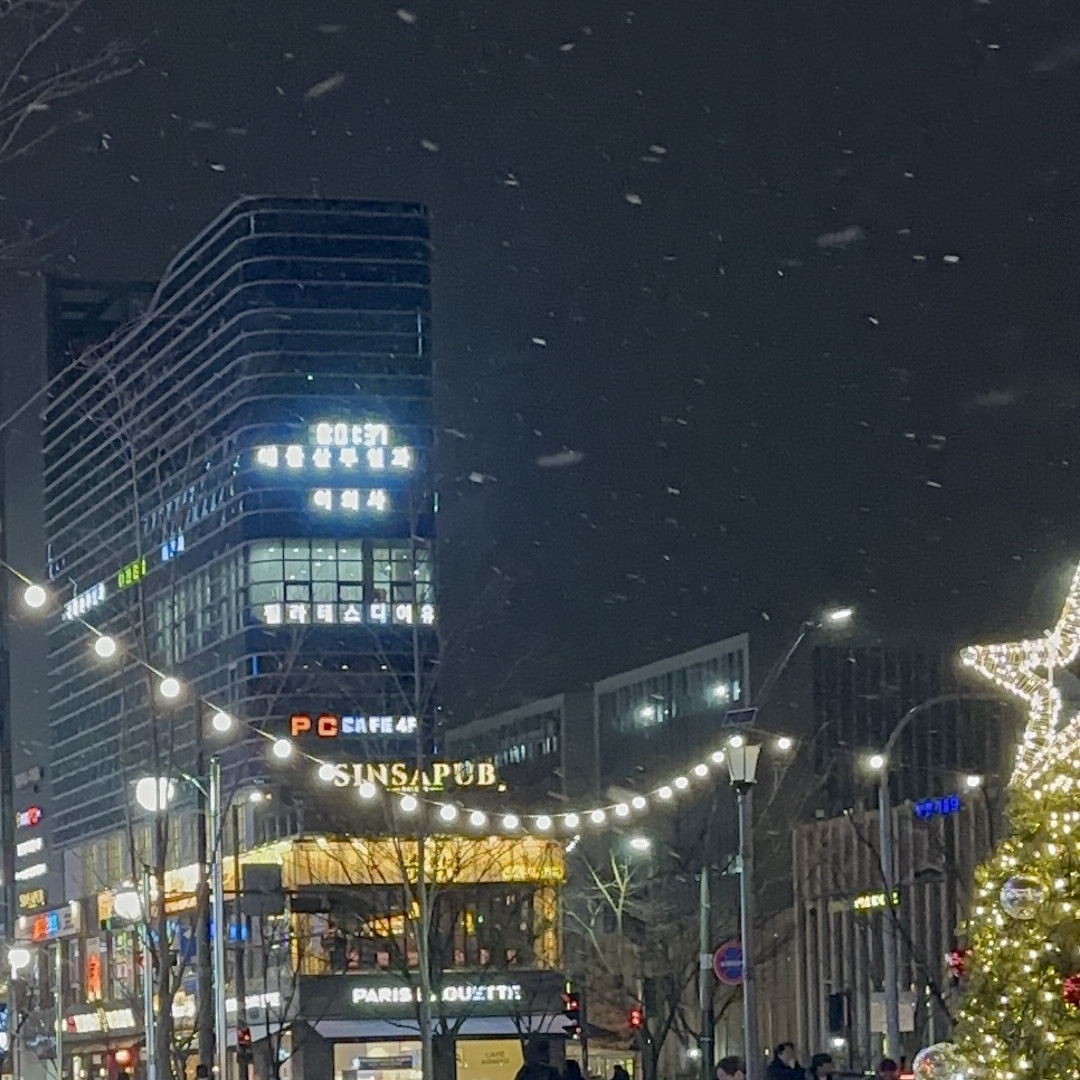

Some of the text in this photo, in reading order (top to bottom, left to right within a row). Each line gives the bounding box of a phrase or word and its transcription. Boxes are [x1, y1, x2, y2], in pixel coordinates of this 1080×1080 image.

[290, 715, 338, 737] PC
[341, 716, 393, 734] CAFE
[352, 984, 521, 1003] PARIS GUETTE
